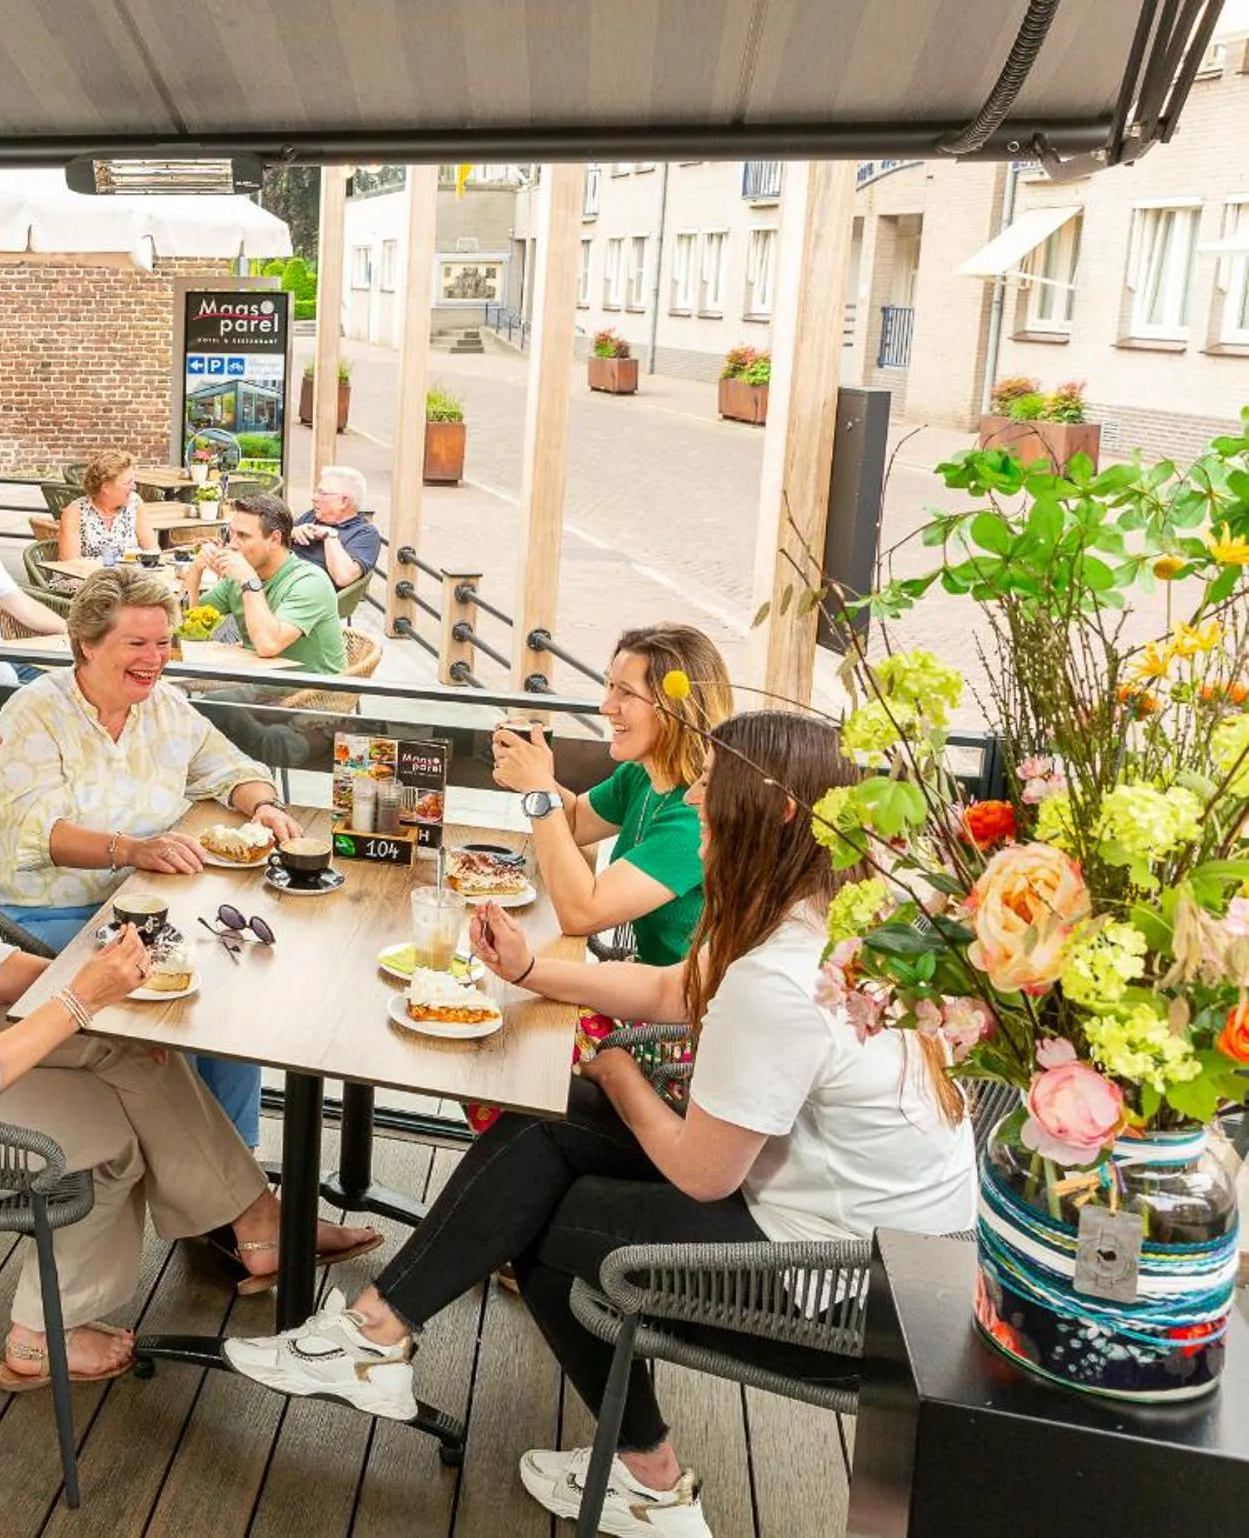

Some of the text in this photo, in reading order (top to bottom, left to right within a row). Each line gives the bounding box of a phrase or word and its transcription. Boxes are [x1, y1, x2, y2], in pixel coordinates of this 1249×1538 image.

[220, 313, 279, 337] parel
[210, 359, 222, 372] P
[365, 839, 399, 859] 104
